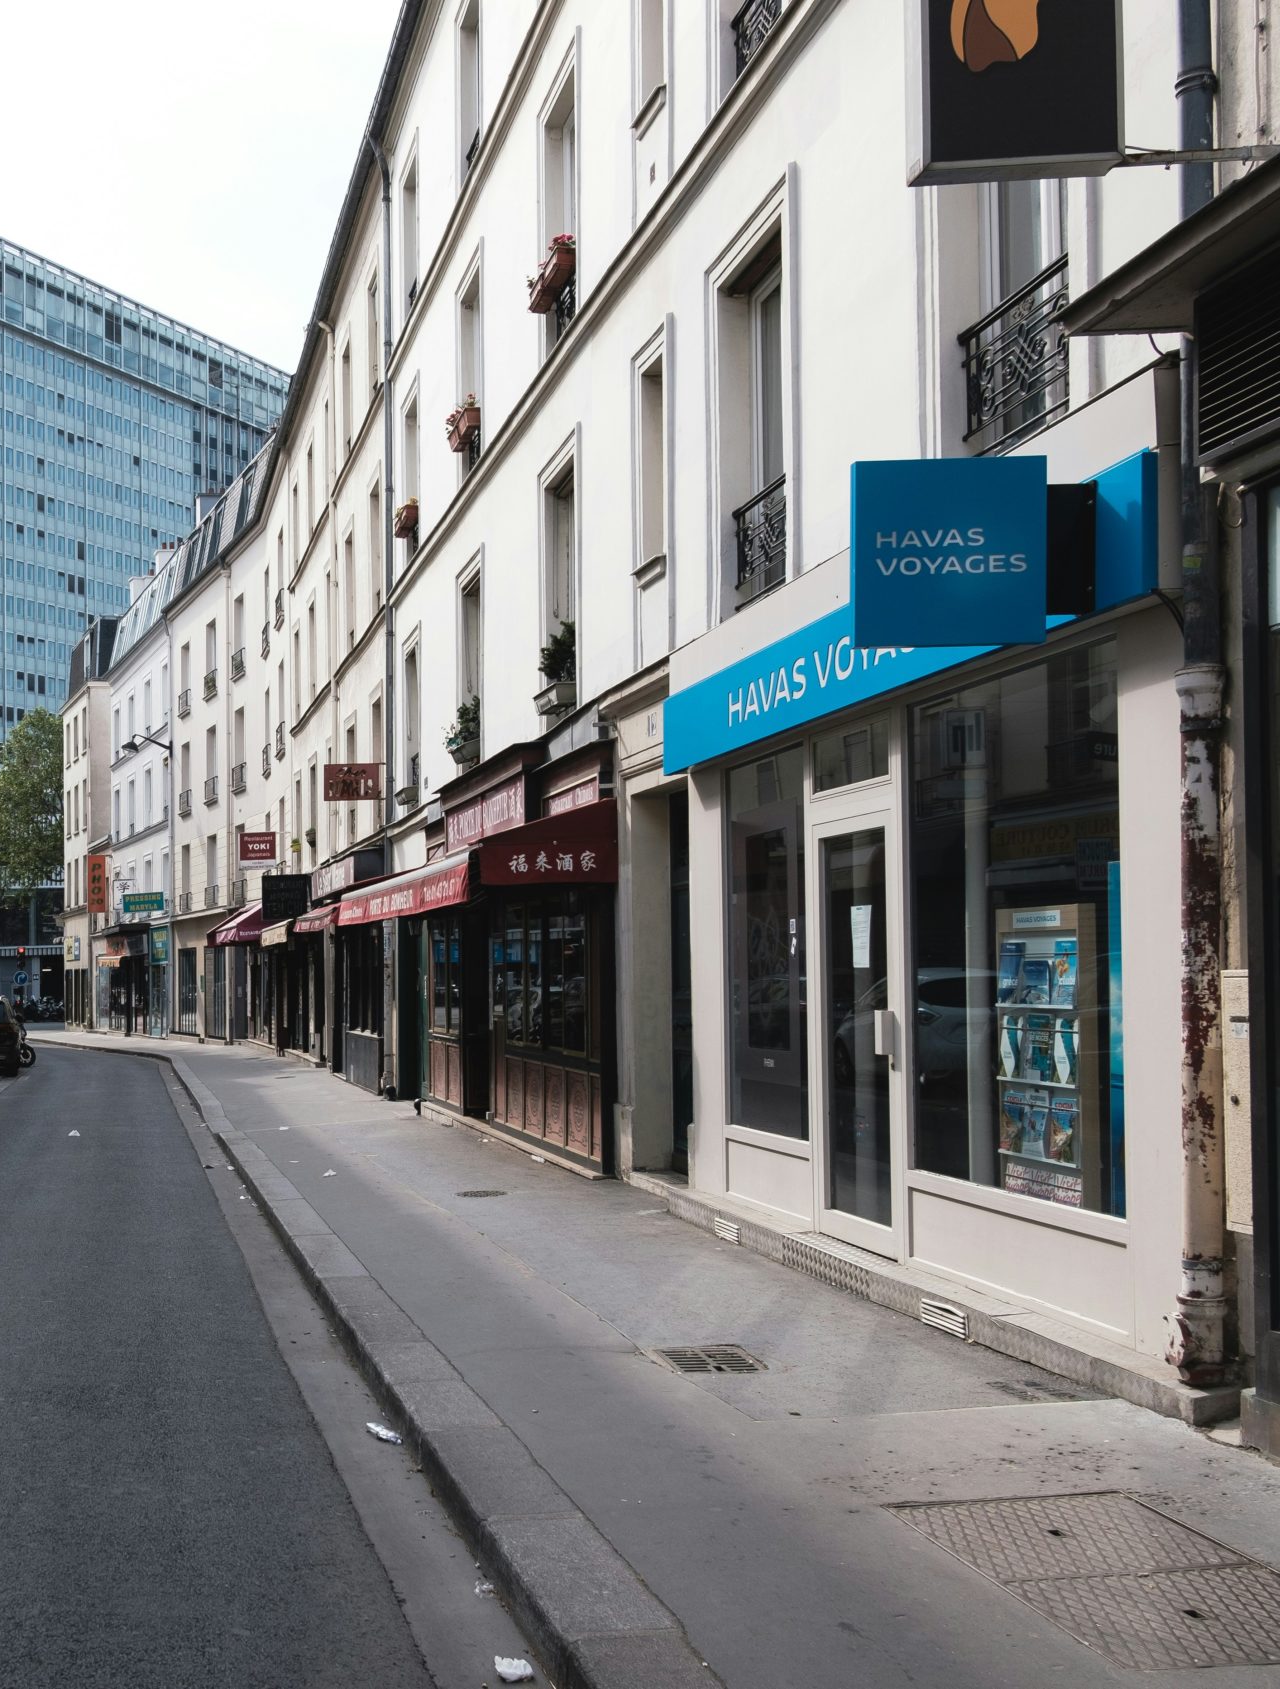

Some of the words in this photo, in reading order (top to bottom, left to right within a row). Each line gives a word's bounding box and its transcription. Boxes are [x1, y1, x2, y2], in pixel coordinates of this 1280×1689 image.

[876, 528, 985, 549] HAVAS
[875, 553, 1028, 576] VOYAGES
[728, 657, 807, 728] HAVAS
[91, 863, 102, 895] PHO
[125, 893, 161, 903] PRESSING
[369, 897, 382, 916] PORTE
[382, 896, 389, 913] DU
[390, 889, 414, 911] BONHEUR
[1033, 914, 1057, 922] VOYAGES
